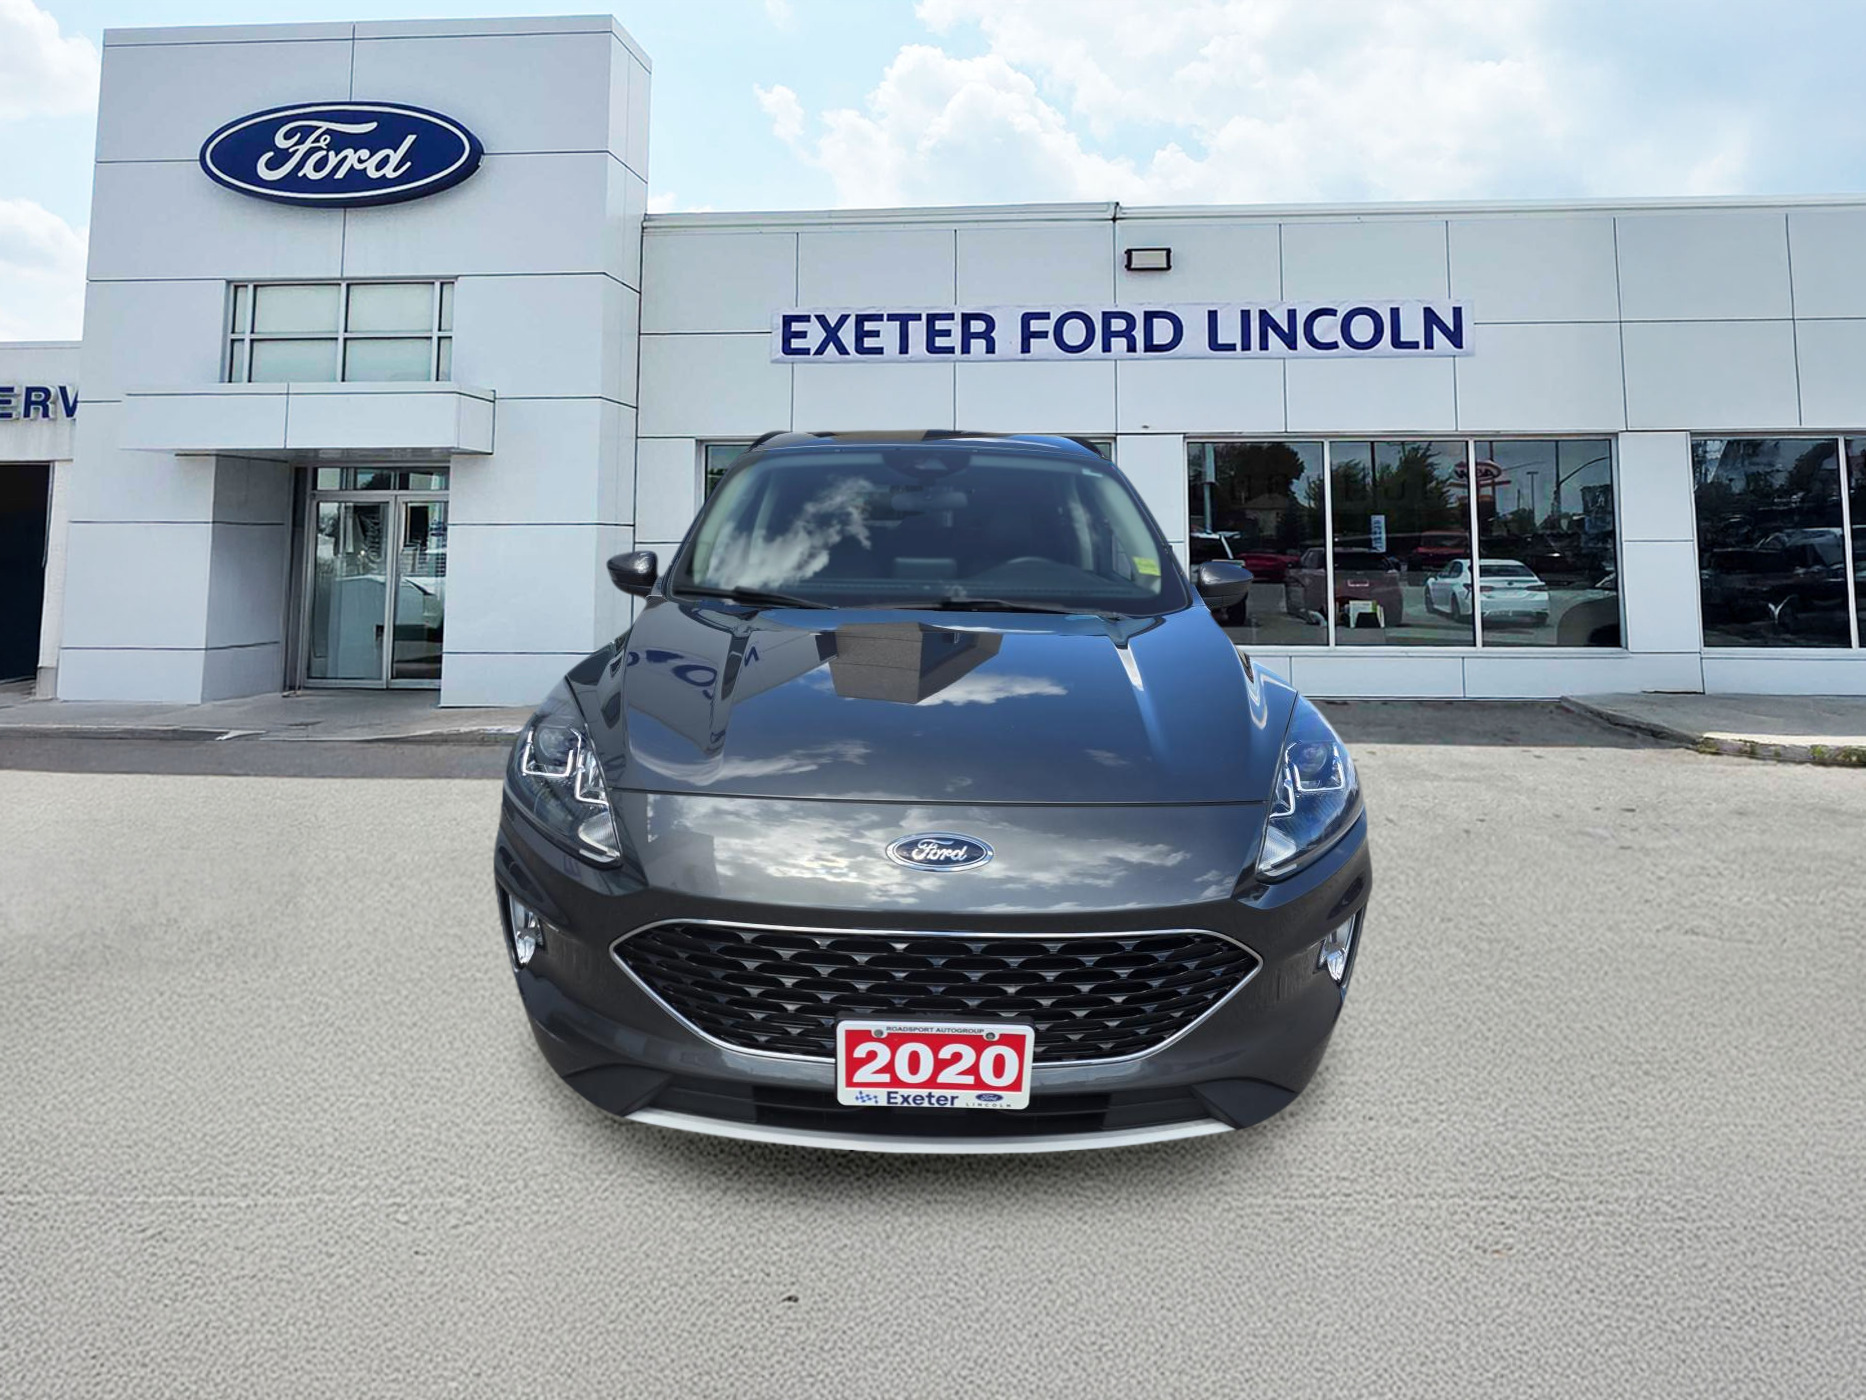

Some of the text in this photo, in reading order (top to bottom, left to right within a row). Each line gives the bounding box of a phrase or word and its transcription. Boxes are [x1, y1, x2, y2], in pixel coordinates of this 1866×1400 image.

[257, 120, 417, 181] Ford
[781, 306, 1464, 356] EXETER FORD LINCOLN
[911, 838, 968, 861] Ford
[852, 1041, 1020, 1087] 2020
[886, 1090, 959, 1106] Exeter
